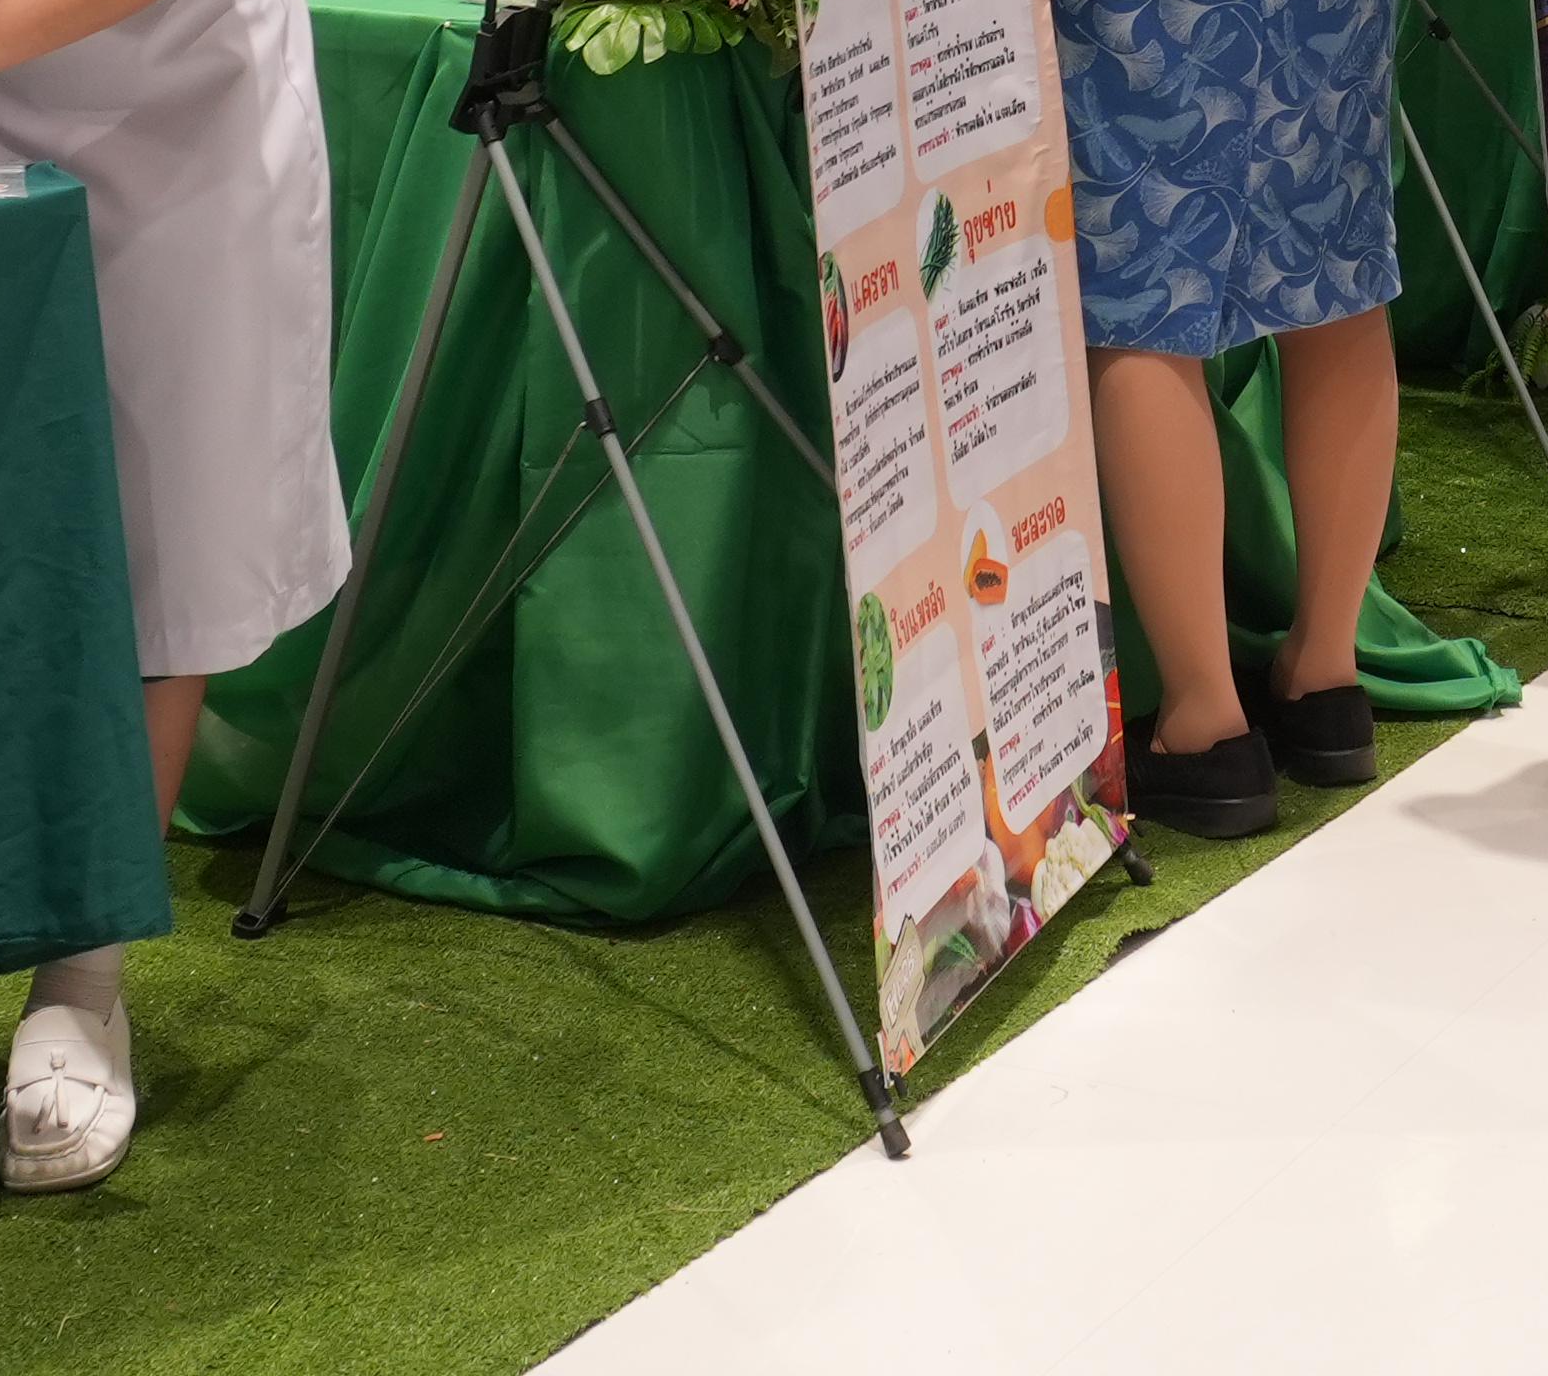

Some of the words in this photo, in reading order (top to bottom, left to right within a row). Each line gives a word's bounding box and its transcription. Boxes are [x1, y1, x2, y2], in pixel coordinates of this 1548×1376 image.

[964, 180, 1016, 265] กุยช่าย
[851, 260, 899, 315] แครอท
[1012, 496, 1066, 555] มะละกอ
[890, 581, 947, 649] ใบแมงลัก
